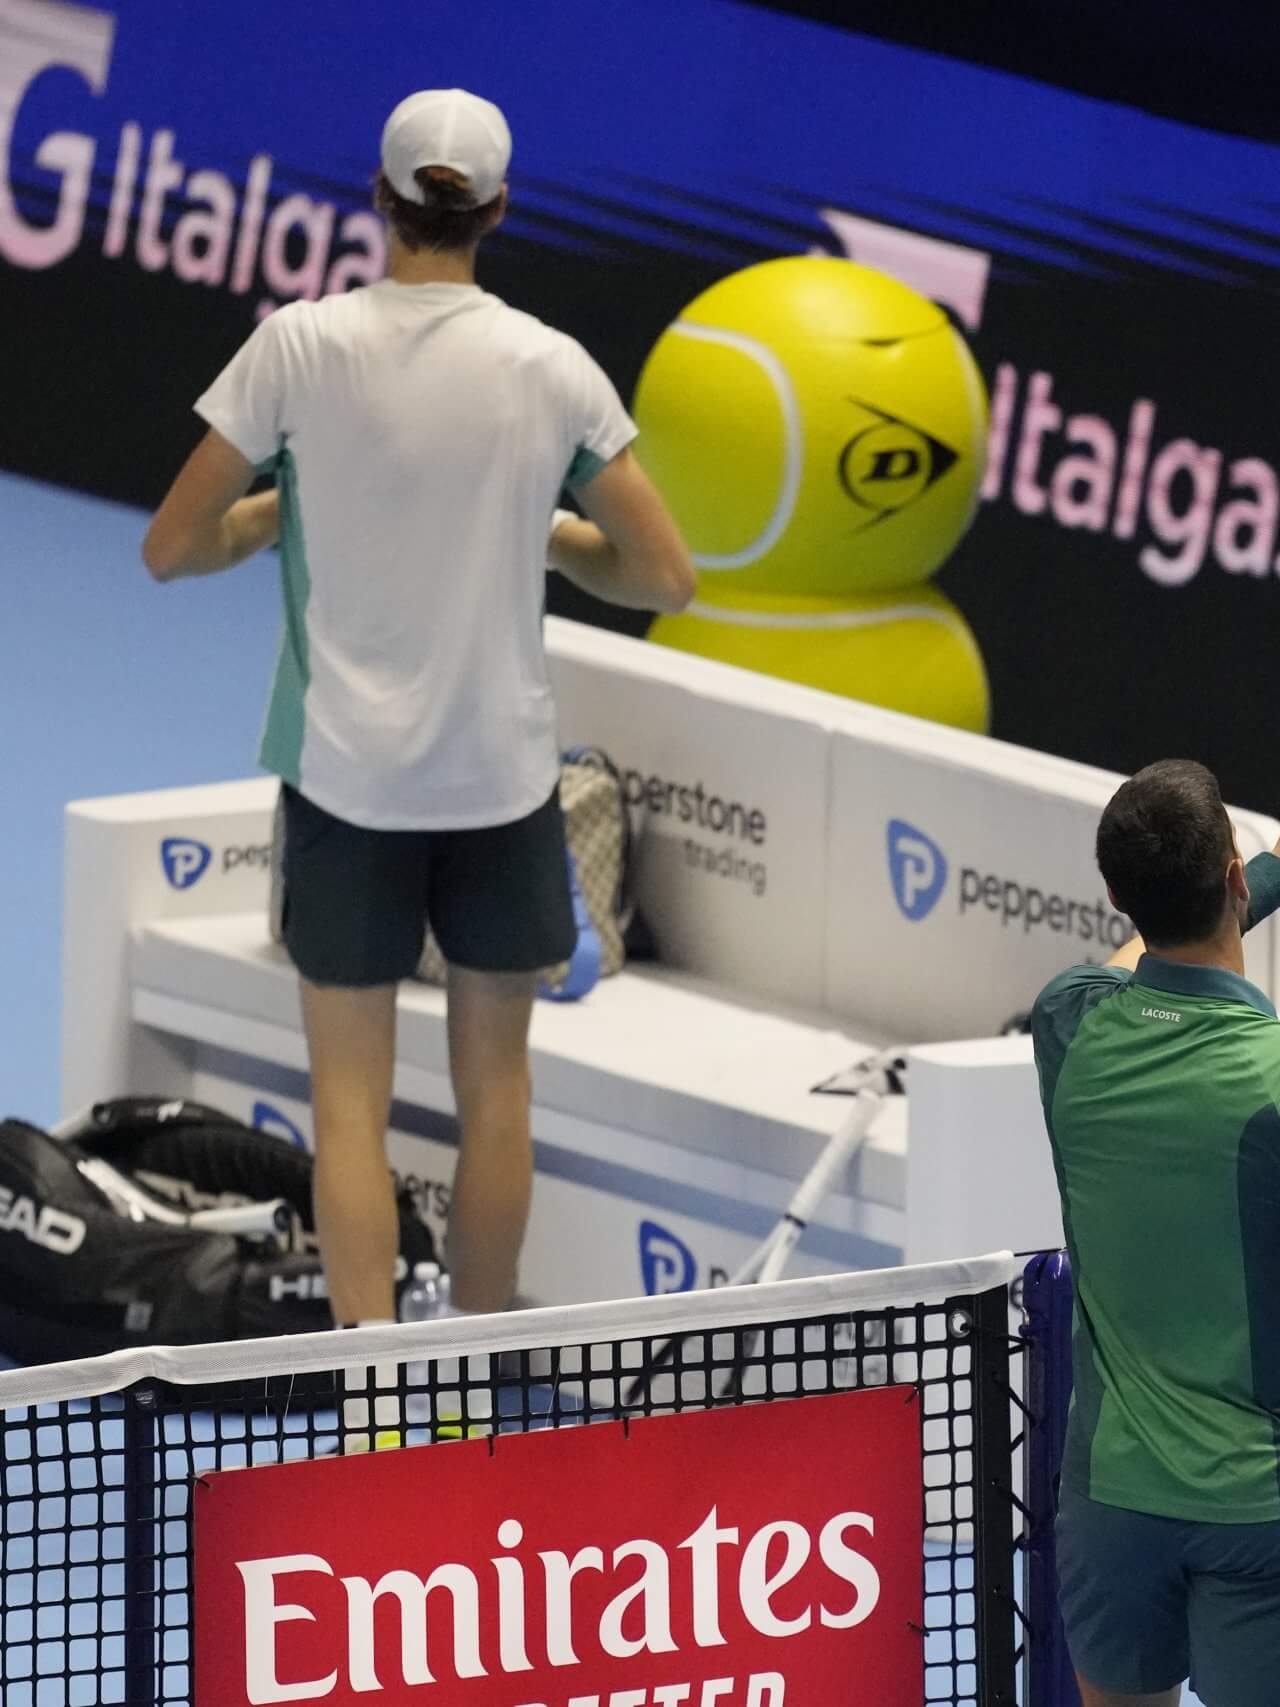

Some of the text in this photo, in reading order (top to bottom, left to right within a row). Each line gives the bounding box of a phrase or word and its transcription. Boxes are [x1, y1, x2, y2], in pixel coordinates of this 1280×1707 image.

[102, 120, 390, 327] Italga
[623, 768, 766, 845] perstone
[957, 864, 1138, 949] peppersto
[1141, 1007, 1182, 1023] LACOSTE
[0, 1184, 87, 1256] EAD
[235, 1503, 881, 1705] Emirates
